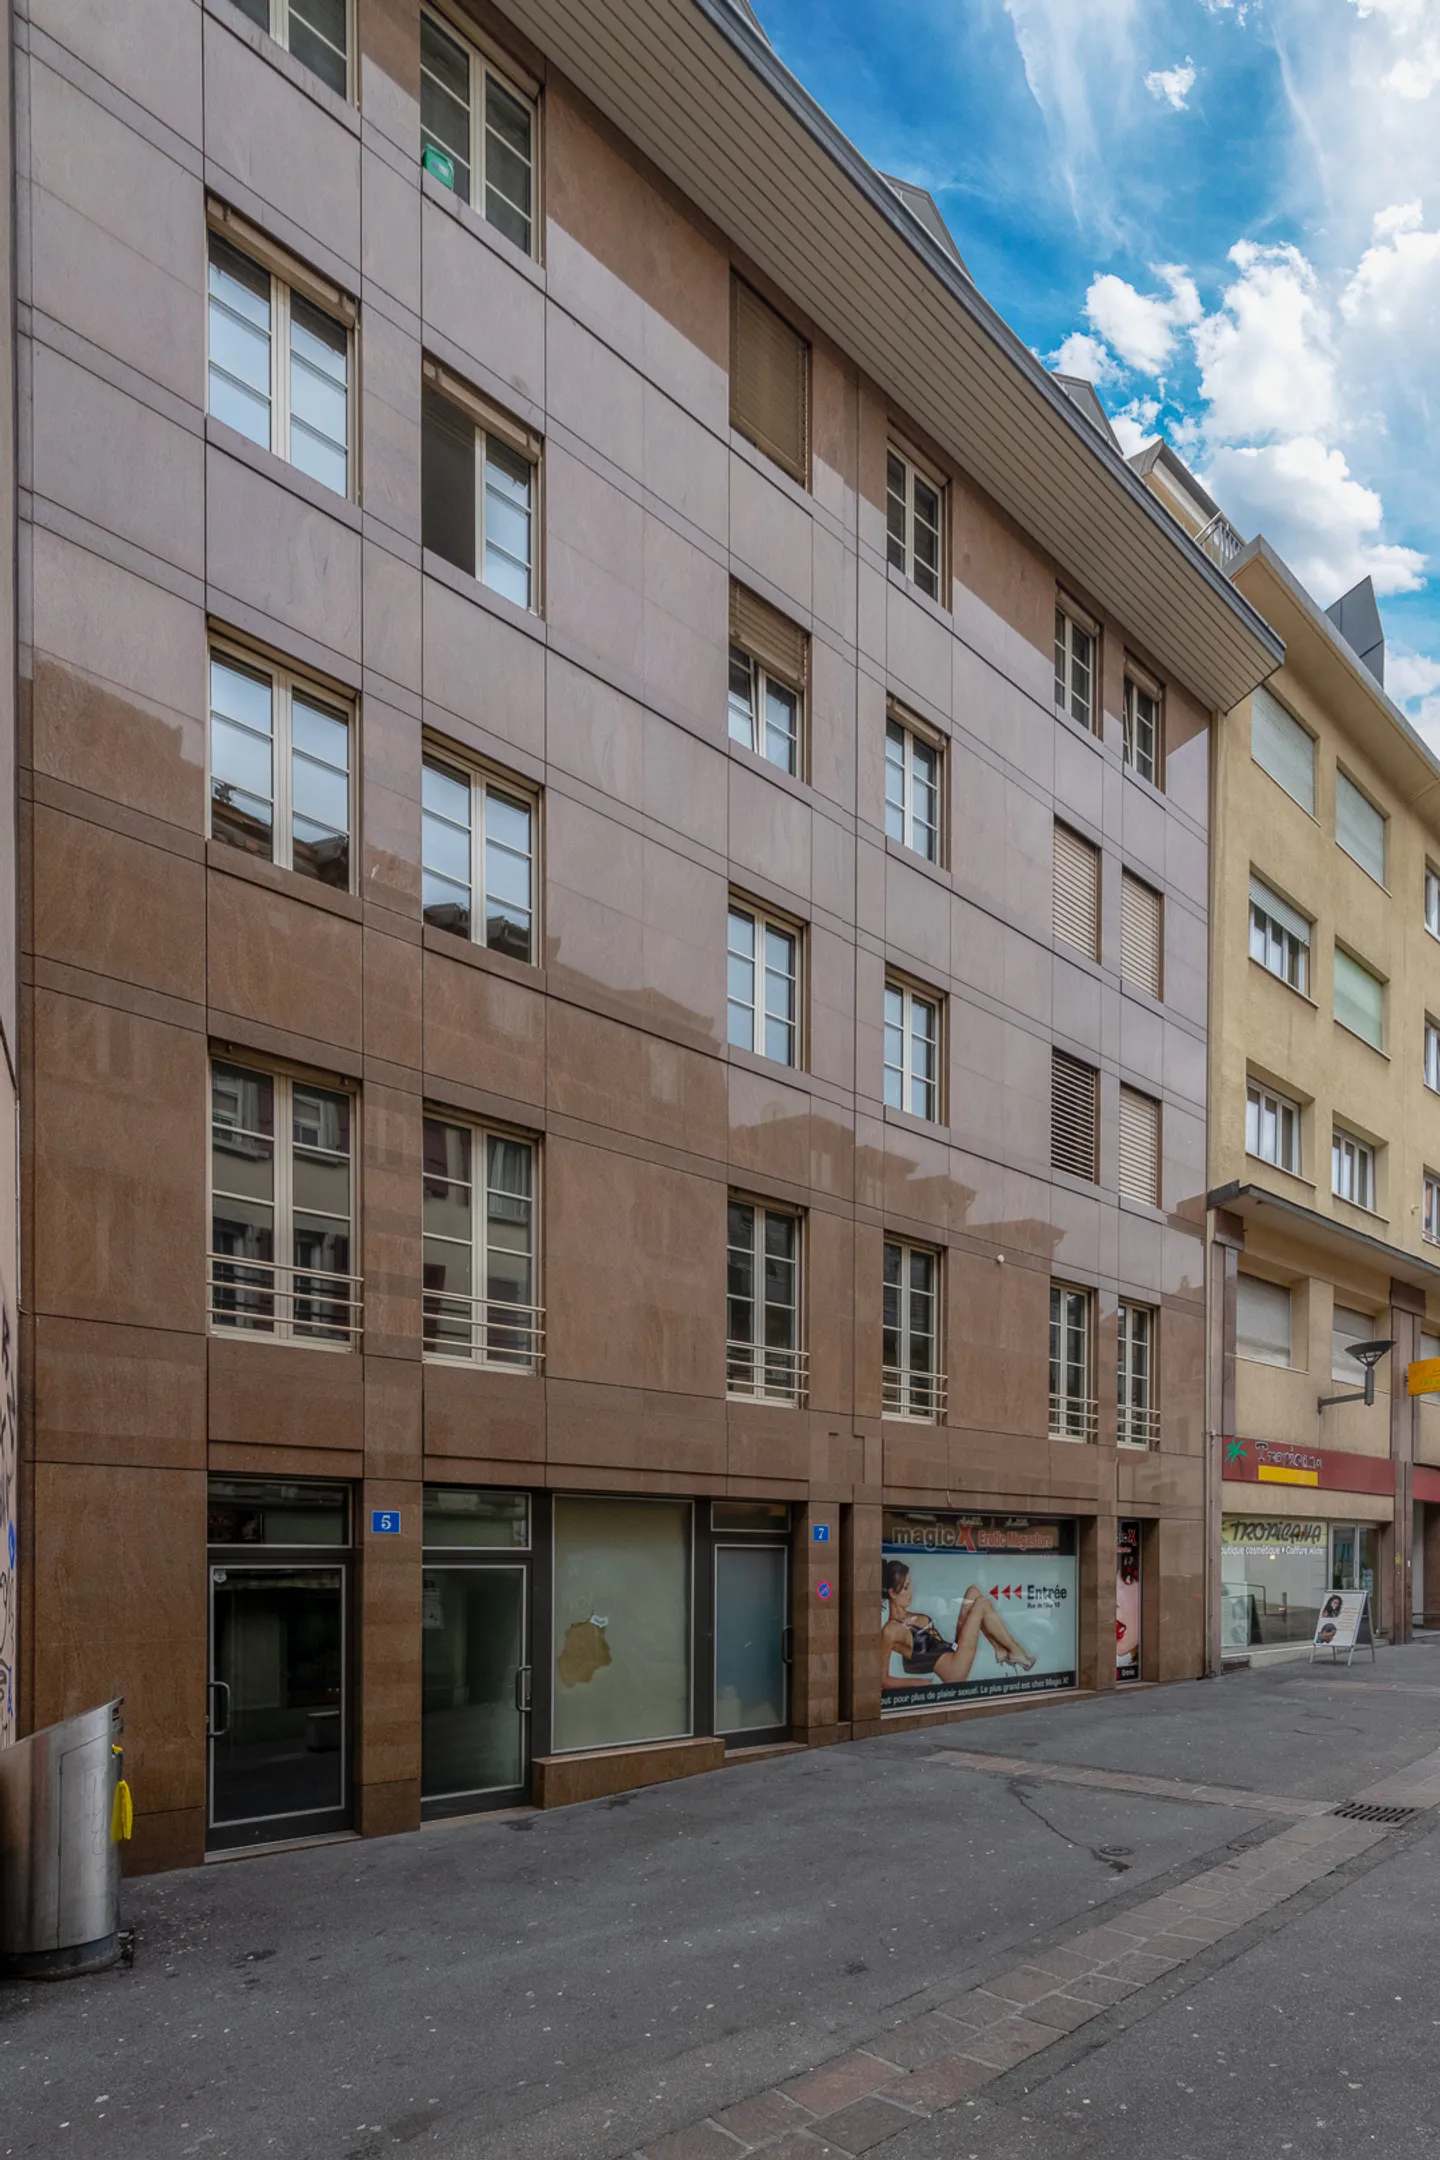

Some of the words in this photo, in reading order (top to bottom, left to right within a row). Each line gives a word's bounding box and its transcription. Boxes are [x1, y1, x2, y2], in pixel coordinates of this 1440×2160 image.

[381, 1514, 392, 1530] 5
[818, 1527, 825, 1540] 7
[978, 1531, 1006, 1548] Erotic
[1007, 1531, 1054, 1551] Megastore
[1027, 1584, 1067, 1600] Entrée
[893, 1695, 909, 1705] pour
[911, 1692, 925, 1704] plus
[927, 1691, 935, 1700] de
[937, 1689, 956, 1700] plaisir
[989, 1684, 1002, 1694] plus
[1003, 1682, 1020, 1693] grand
[1021, 1681, 1031, 1689] est
[1032, 1679, 1045, 1688] chez
[1045, 1677, 1062, 1687] Magic
